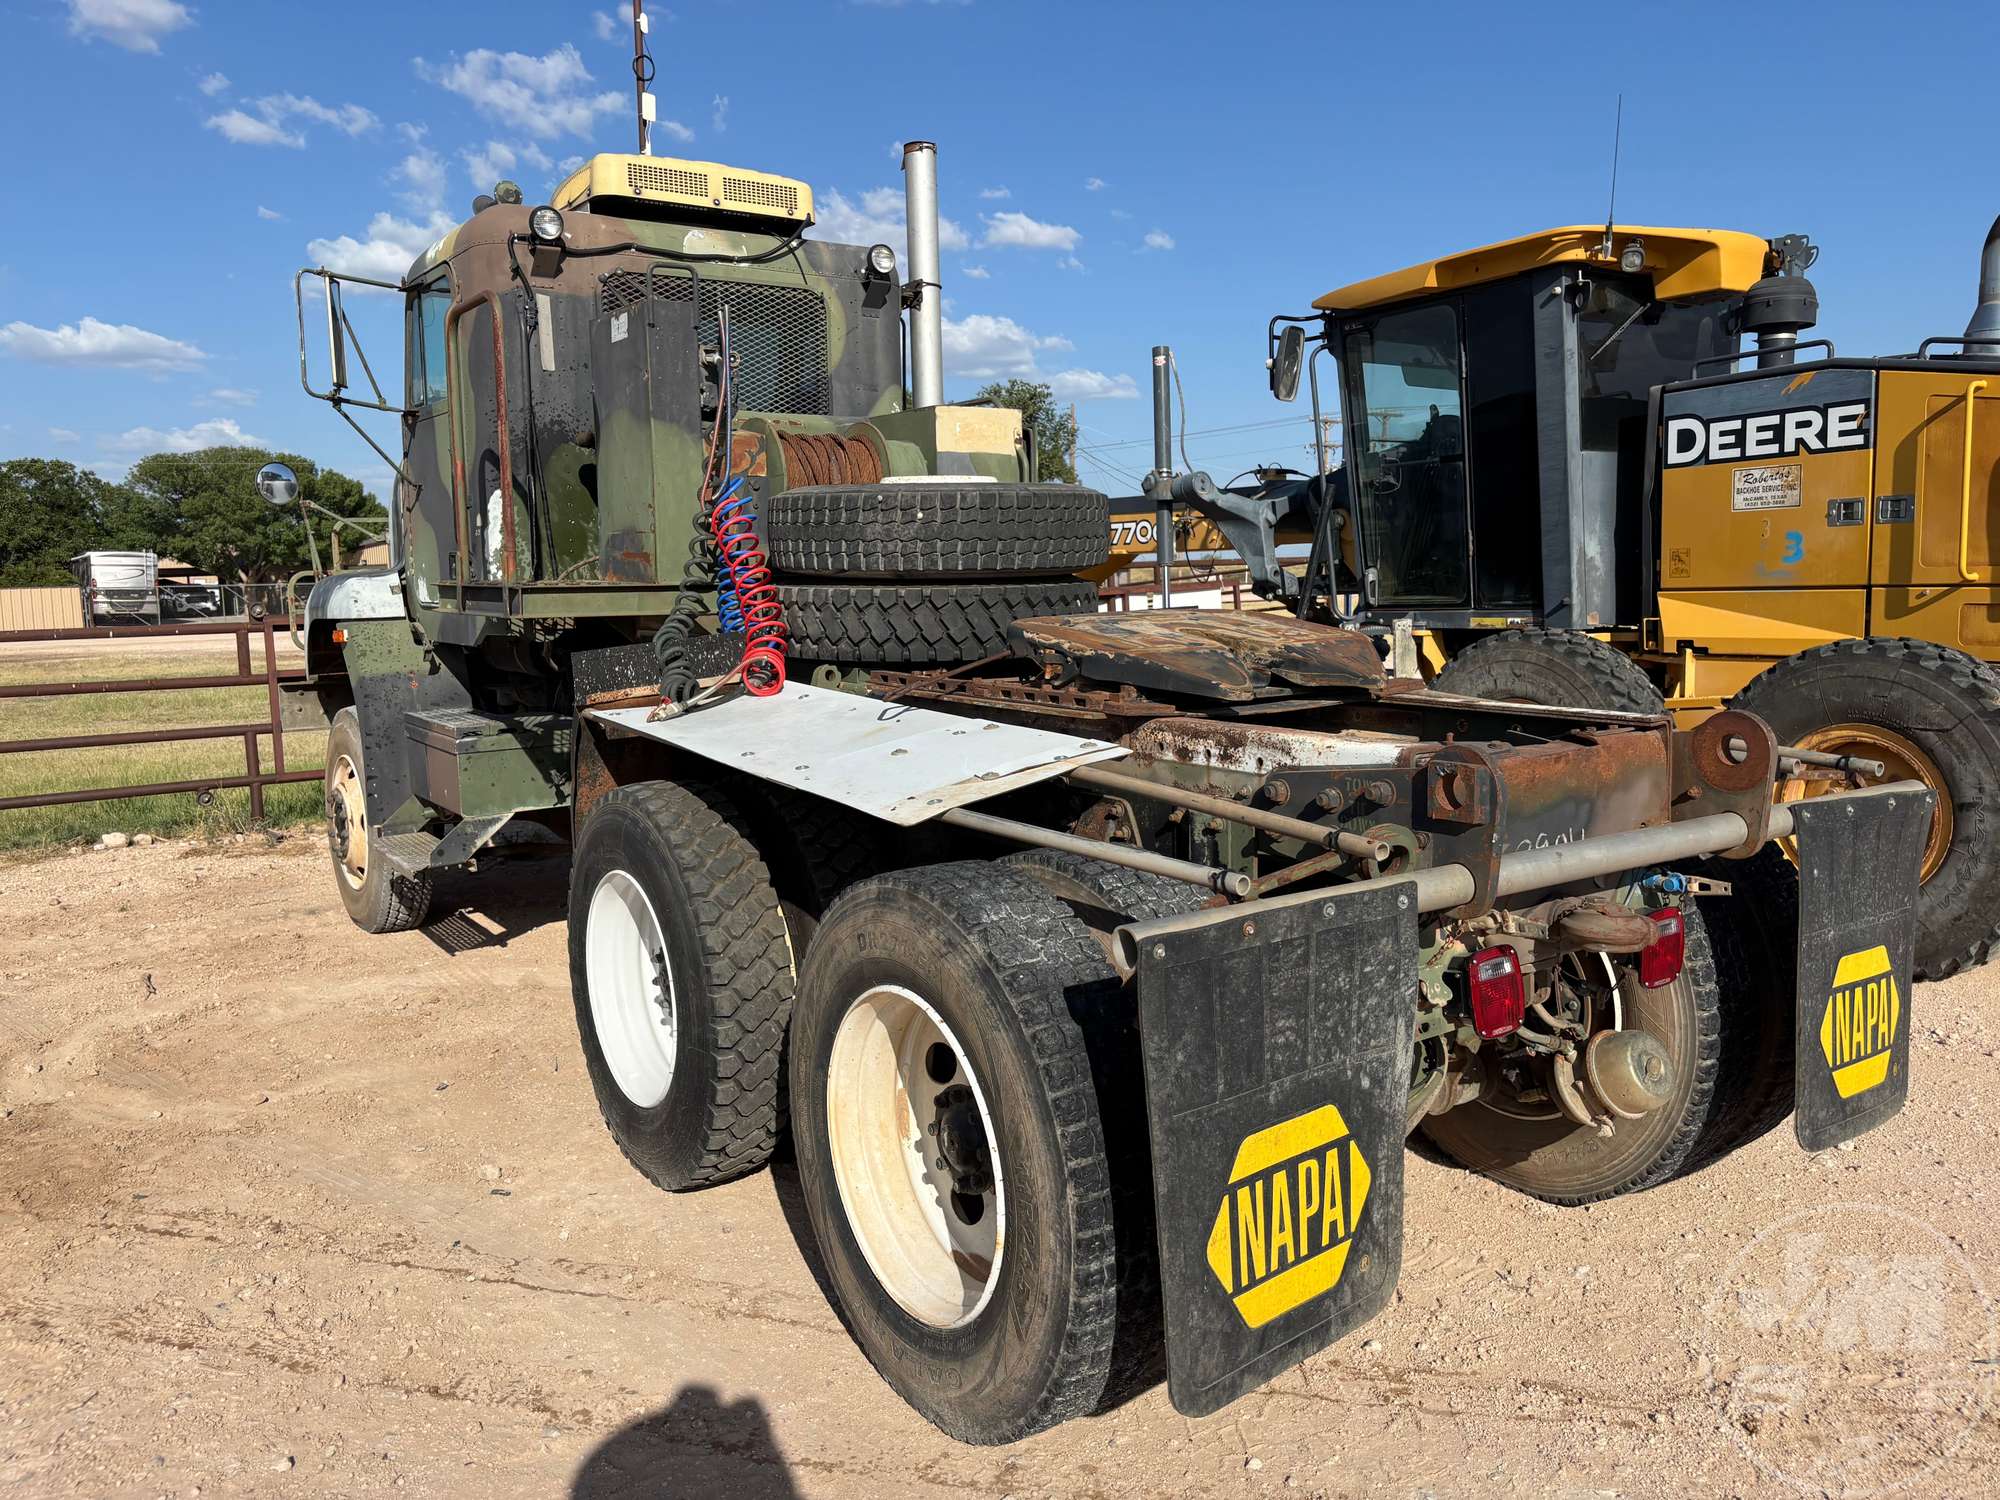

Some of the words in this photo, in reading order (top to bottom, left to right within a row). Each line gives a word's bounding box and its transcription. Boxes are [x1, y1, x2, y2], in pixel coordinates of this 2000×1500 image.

[1667, 403, 1865, 465] DEERE
[1736, 485, 1761, 495] BACKHOE
[1782, 530, 1804, 565] 3
[1836, 977, 1889, 1066] NAPA
[1236, 1147, 1345, 1288] NAPA
